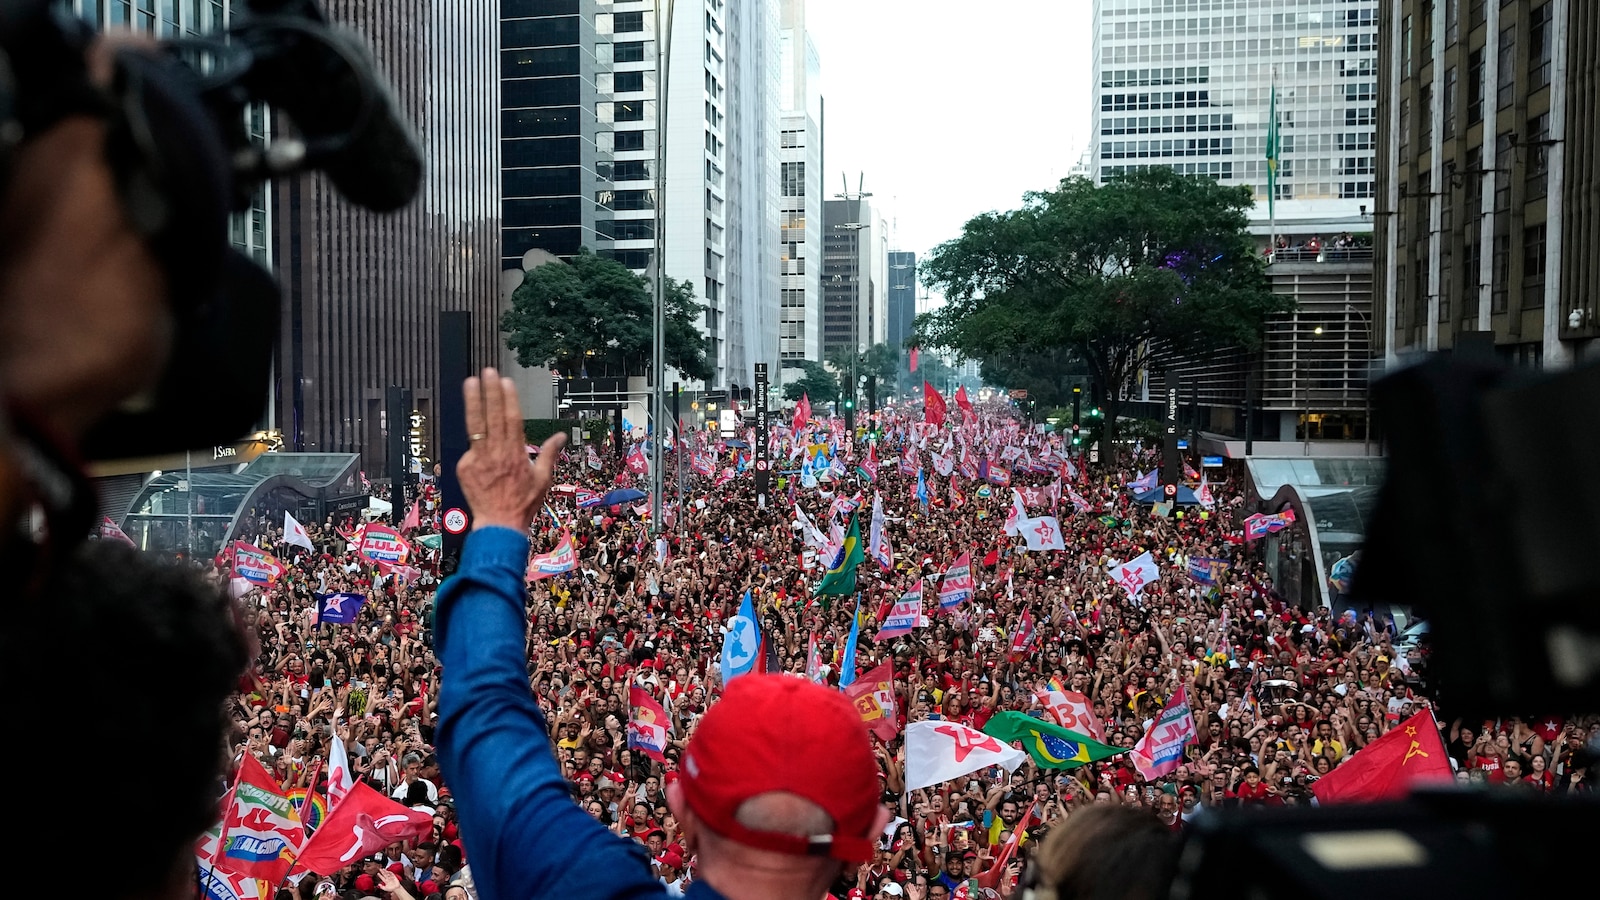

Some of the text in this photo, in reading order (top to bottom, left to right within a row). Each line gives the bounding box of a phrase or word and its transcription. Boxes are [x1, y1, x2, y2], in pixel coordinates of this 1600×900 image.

[1168, 388, 1177, 433] R. Augusta
[757, 412, 765, 430] João
[758, 449, 765, 457] R.
[364, 540, 404, 552] LULA
